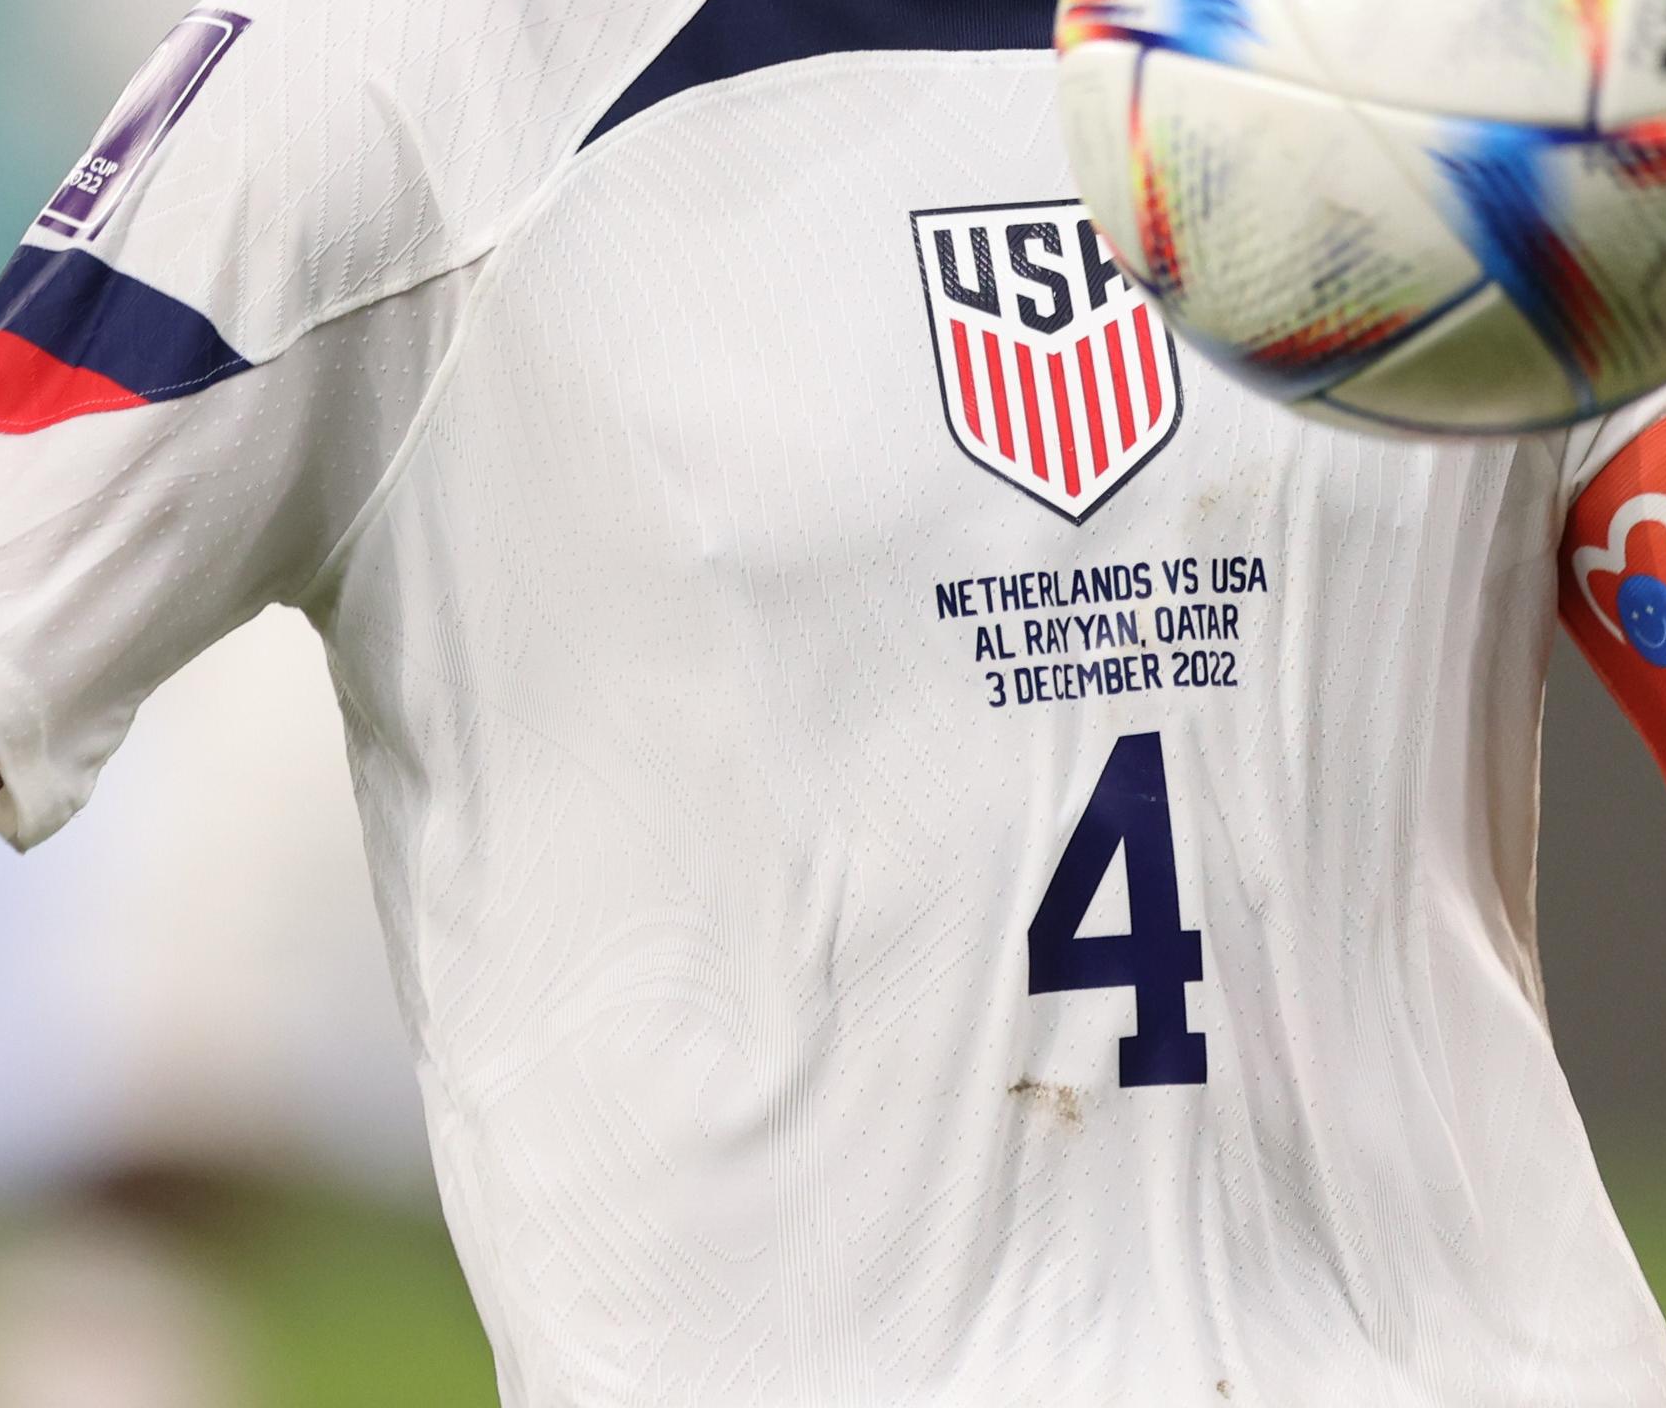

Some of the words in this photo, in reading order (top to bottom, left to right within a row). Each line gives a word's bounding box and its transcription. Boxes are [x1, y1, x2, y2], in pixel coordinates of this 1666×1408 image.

[65, 169, 103, 195] 022
[90, 157, 119, 177] CUP
[935, 562, 1152, 619] NETHERLANDS
[1162, 558, 1198, 595] VS
[1212, 557, 1268, 593] USA
[976, 624, 1016, 662] AL
[1024, 610, 1147, 656] RAYYAN,
[1155, 604, 1239, 643] QATAR
[985, 672, 1006, 708] 3
[1013, 653, 1163, 705] DECEMBER
[1172, 650, 1238, 688] 2022
[1028, 731, 1208, 1088] 4
